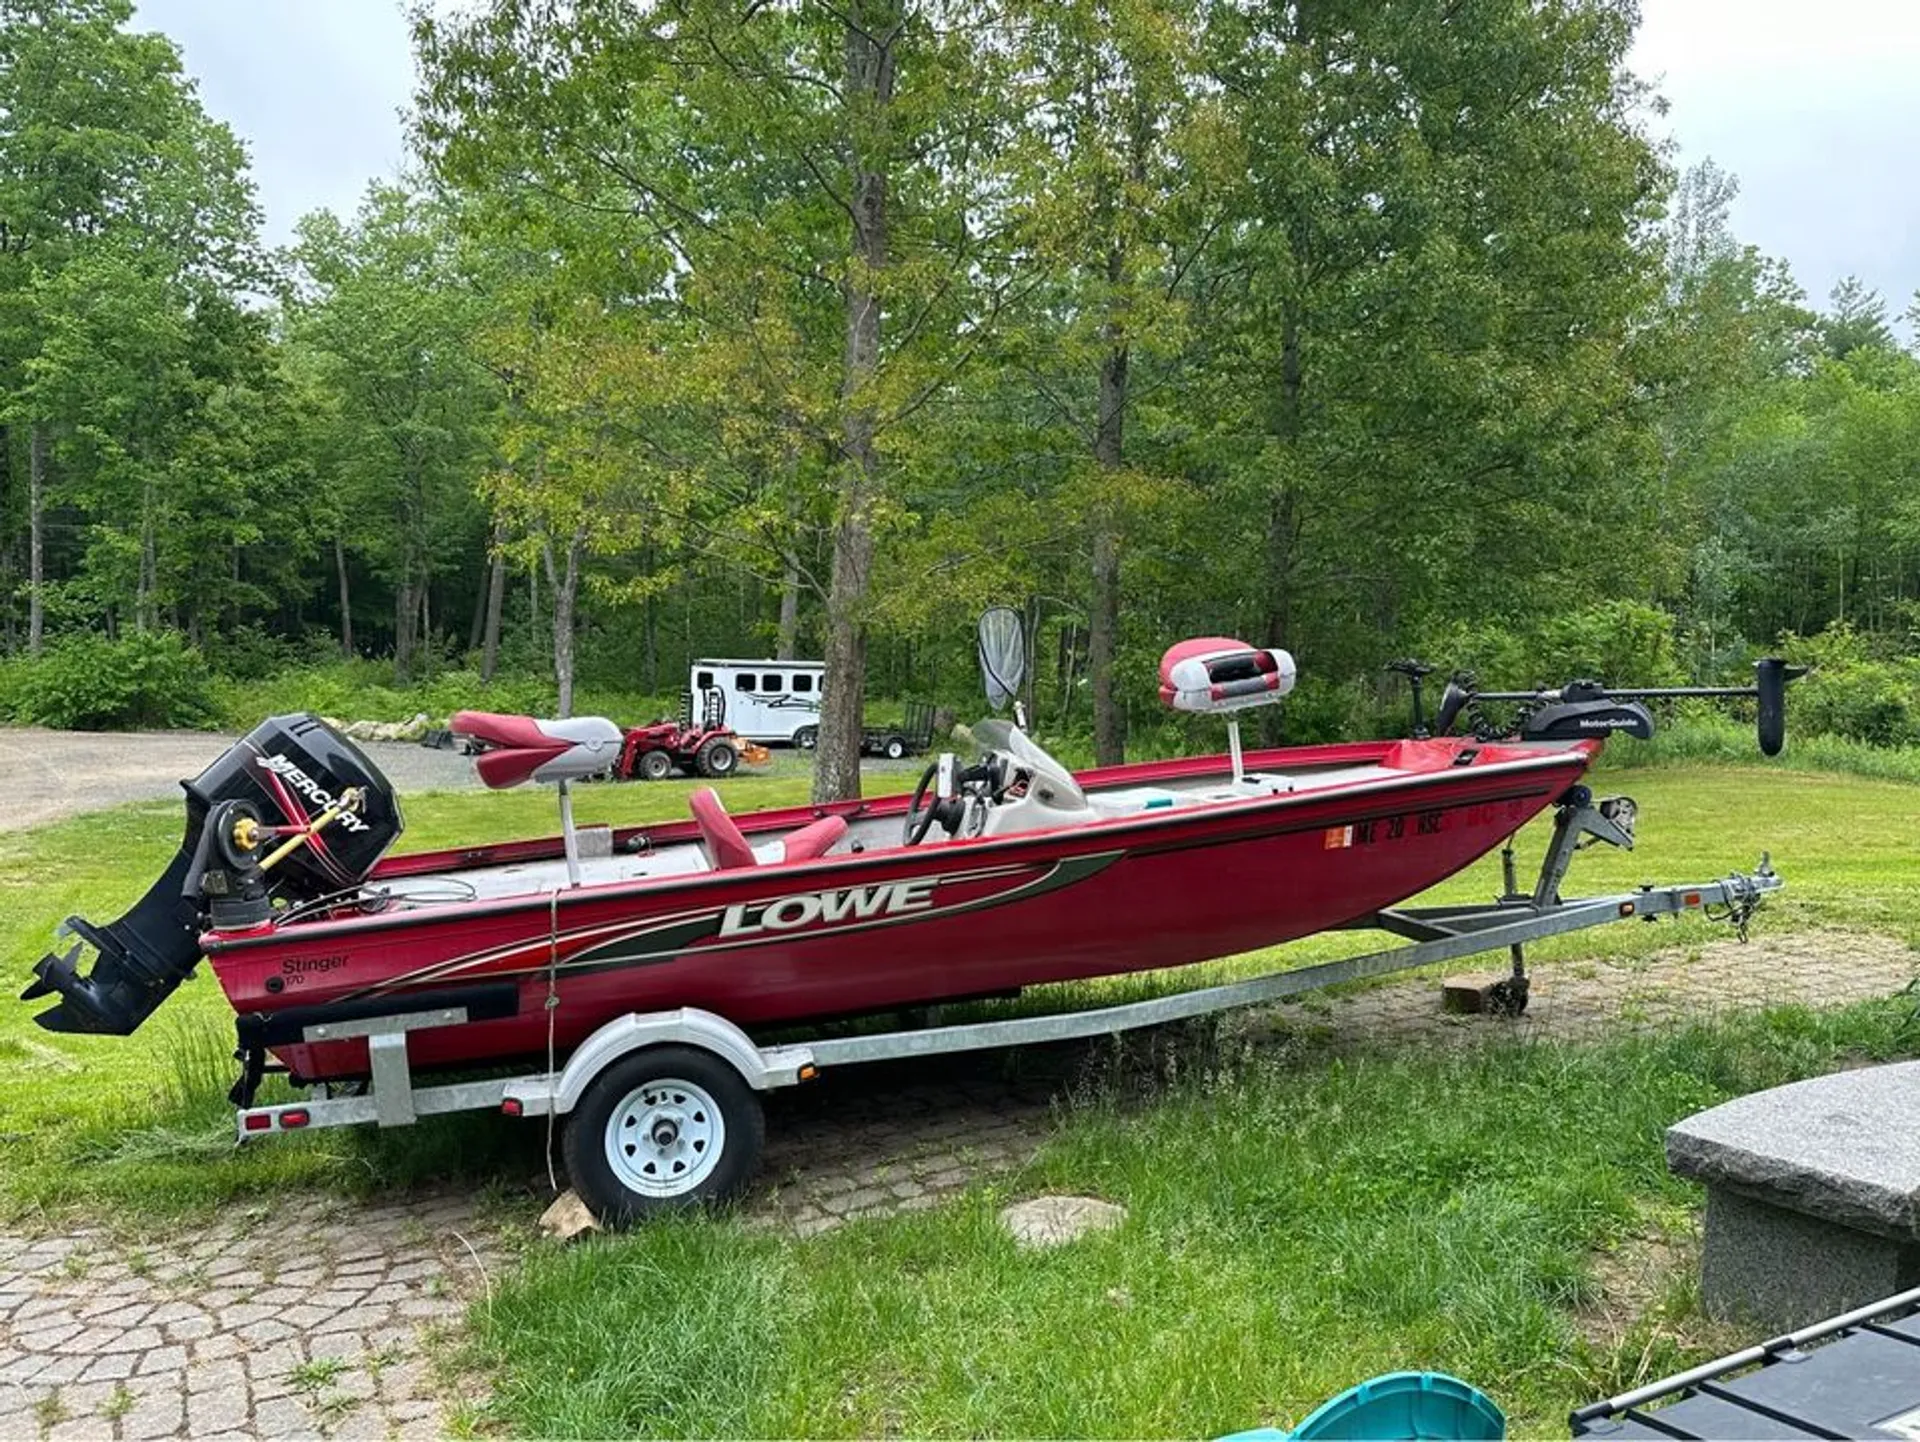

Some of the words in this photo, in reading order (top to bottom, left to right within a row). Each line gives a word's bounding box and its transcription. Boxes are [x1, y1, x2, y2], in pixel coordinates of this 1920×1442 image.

[719, 878, 941, 938] LOWE
[282, 955, 349, 975] Stinger
[286, 974, 305, 986] 170
